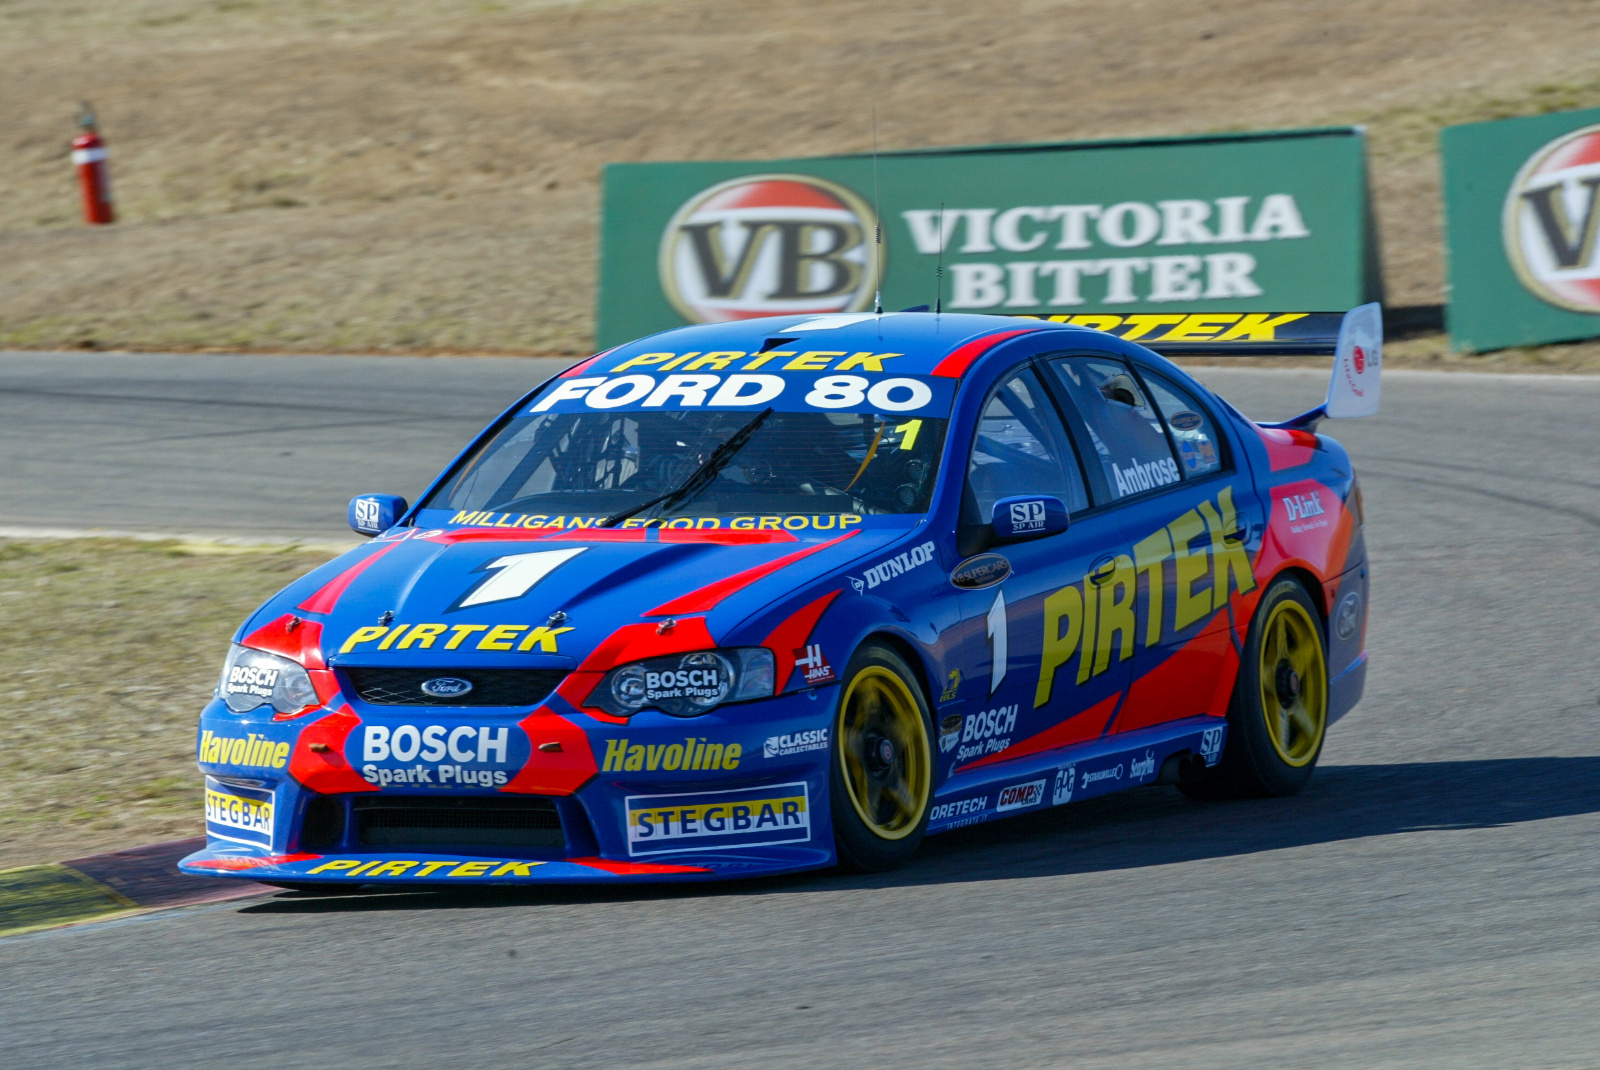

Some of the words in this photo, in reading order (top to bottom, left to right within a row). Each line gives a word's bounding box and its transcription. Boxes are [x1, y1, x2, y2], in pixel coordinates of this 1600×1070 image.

[904, 194, 1311, 254] VICTORIA
[678, 220, 867, 300] VB
[949, 252, 1263, 308] BITTER
[1012, 313, 1310, 341] RTEK
[609, 350, 905, 372] PIRTEK
[529, 373, 786, 413] FORD
[805, 374, 932, 411] 80
[894, 419, 923, 450] 1
[1112, 453, 1181, 496] Ambrose
[356, 501, 377, 520] SP
[1012, 502, 1044, 523] SP
[1282, 490, 1325, 522] D-Link
[621, 517, 721, 530] FOOD
[730, 515, 863, 530] GROUP
[1013, 523, 1025, 531] SP
[1028, 520, 1045, 529] AIR
[459, 546, 589, 608] 1
[863, 541, 936, 590] DUNLOP
[1033, 485, 1256, 709] PIRTEK
[339, 624, 576, 653] PIRTEK
[987, 589, 1008, 695] 1
[227, 682, 248, 695] Spark
[249, 684, 274, 698] Plugs
[229, 665, 279, 687] BOSCH
[646, 669, 718, 689] BOSCH
[646, 688, 682, 700] Spark
[685, 687, 719, 699] Plugs
[962, 703, 1019, 743] BOSCH
[199, 730, 291, 770] Havoline
[363, 724, 509, 763] BOSCH
[779, 728, 828, 748] CLASSIC
[779, 741, 828, 756] CARLECTABLES
[957, 743, 983, 762] Spark
[984, 737, 1011, 753] Plugs
[1201, 728, 1221, 754] SP
[602, 737, 742, 772] Havoline
[362, 765, 432, 787] Spark
[440, 765, 508, 787] Plugs
[1000, 784, 1036, 806] COMP
[206, 792, 271, 833] STEGBAR
[638, 801, 800, 838] STEGBAR
[306, 860, 549, 878] PIRTEK
